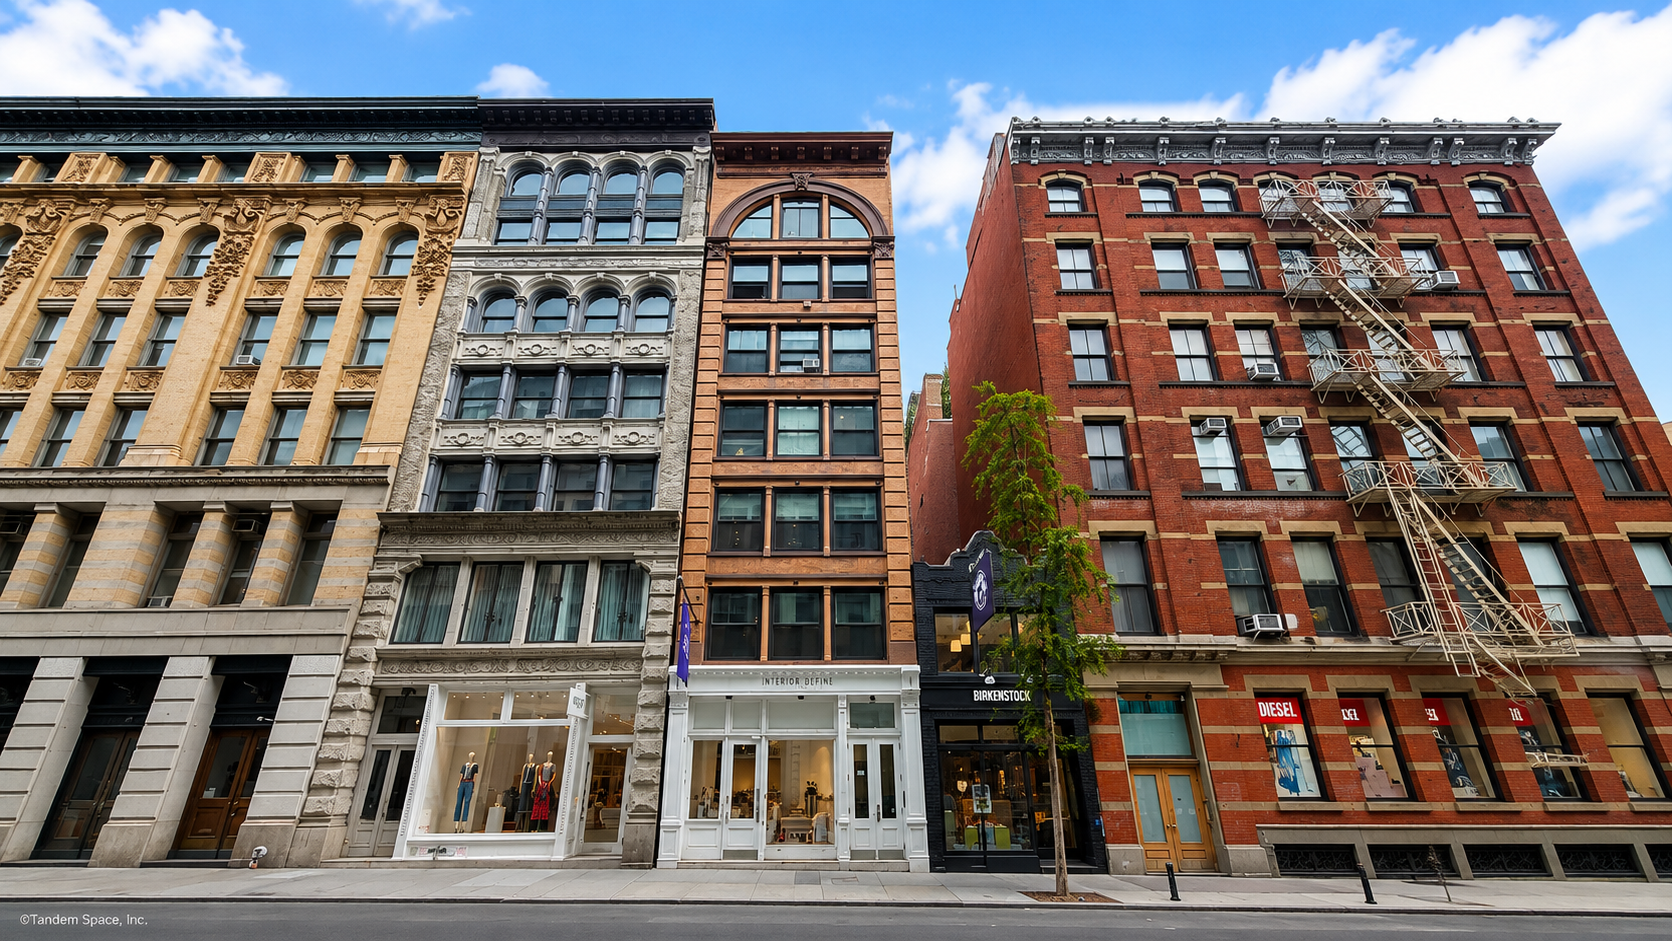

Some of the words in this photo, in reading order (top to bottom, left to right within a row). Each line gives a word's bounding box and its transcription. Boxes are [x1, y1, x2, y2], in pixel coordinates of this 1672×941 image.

[761, 677, 800, 686] INTERIOR
[973, 690, 1031, 701] BIRKENSTOCK
[1258, 702, 1297, 717] DIESEL
